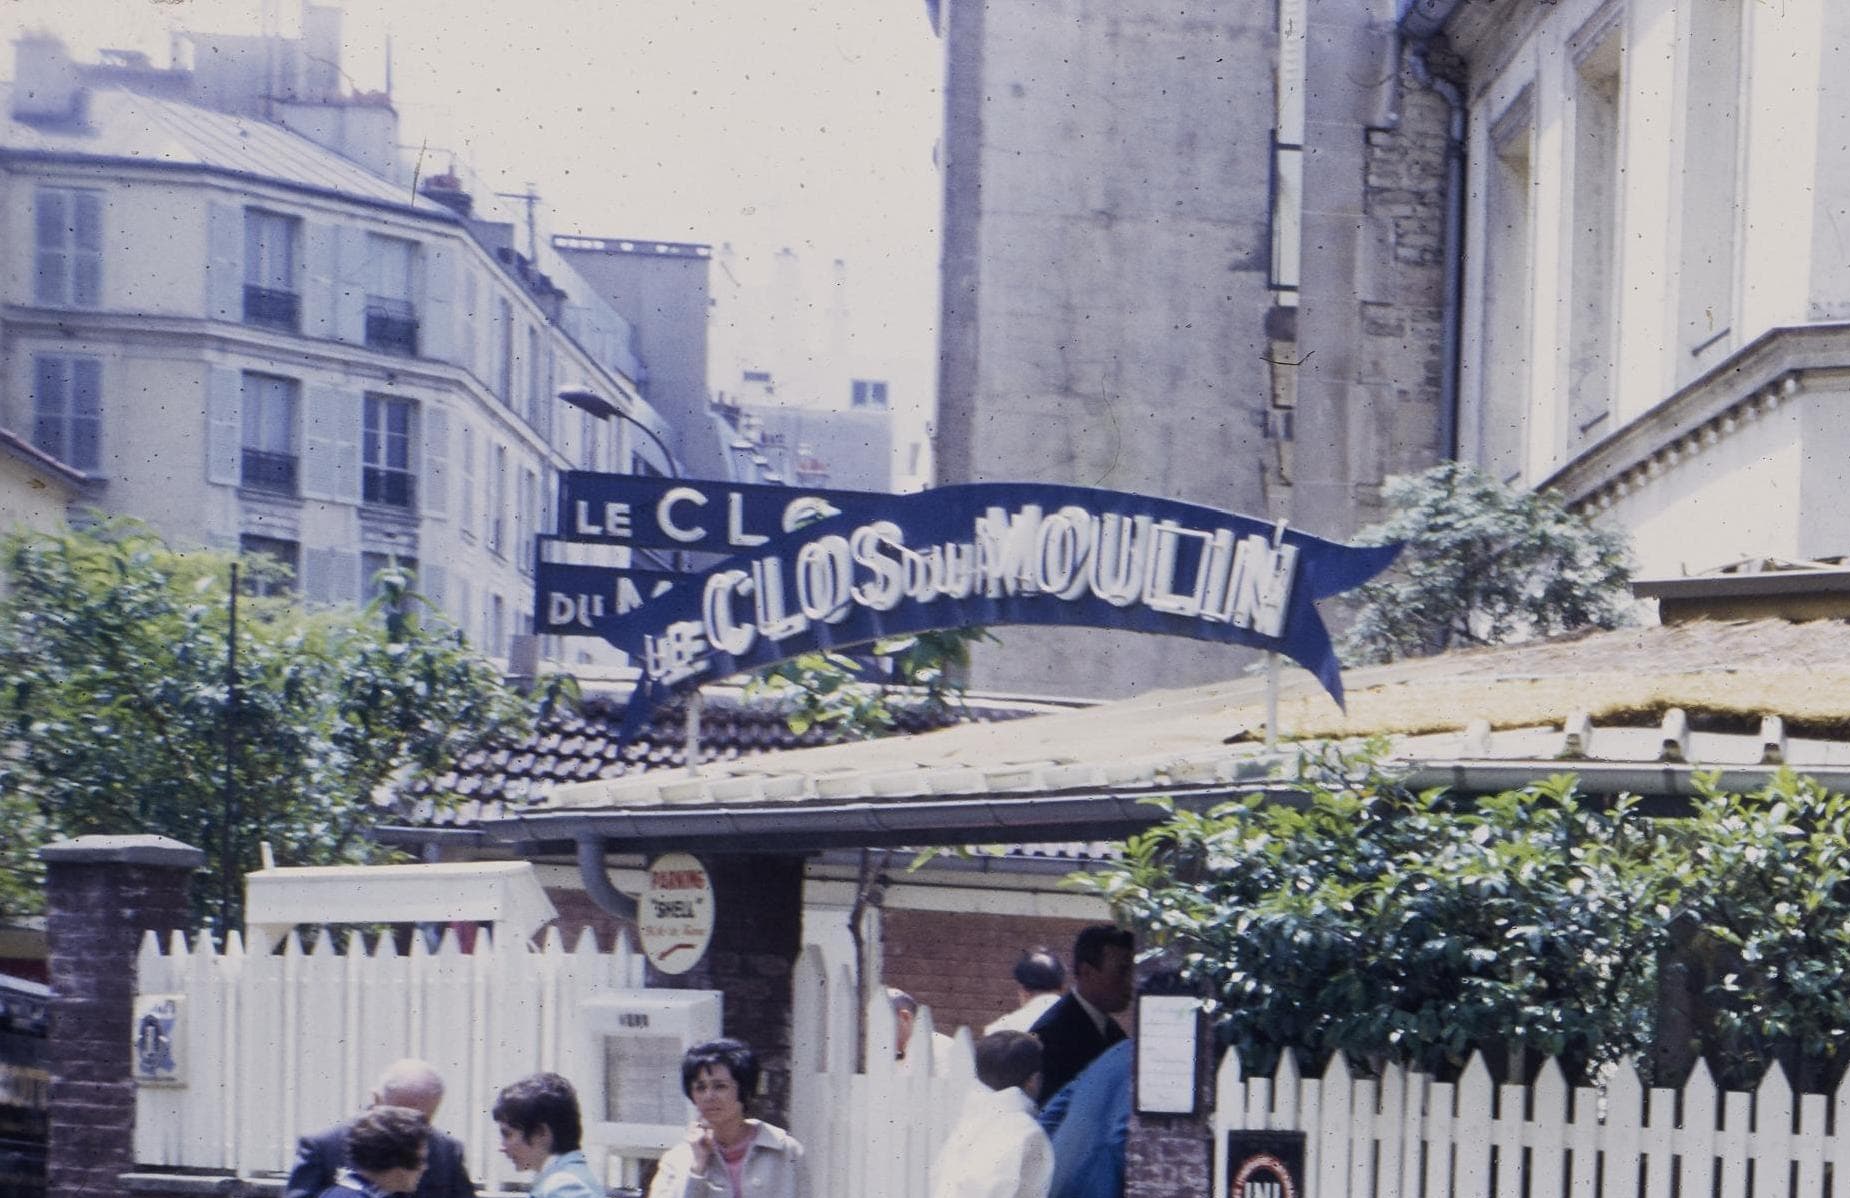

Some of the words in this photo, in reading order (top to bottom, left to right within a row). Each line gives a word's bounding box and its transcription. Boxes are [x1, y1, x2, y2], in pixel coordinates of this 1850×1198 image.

[577, 500, 632, 538] LE
[644, 620, 711, 686] LE
[703, 520, 903, 657] CLOS
[974, 504, 1298, 638] MOULIN
